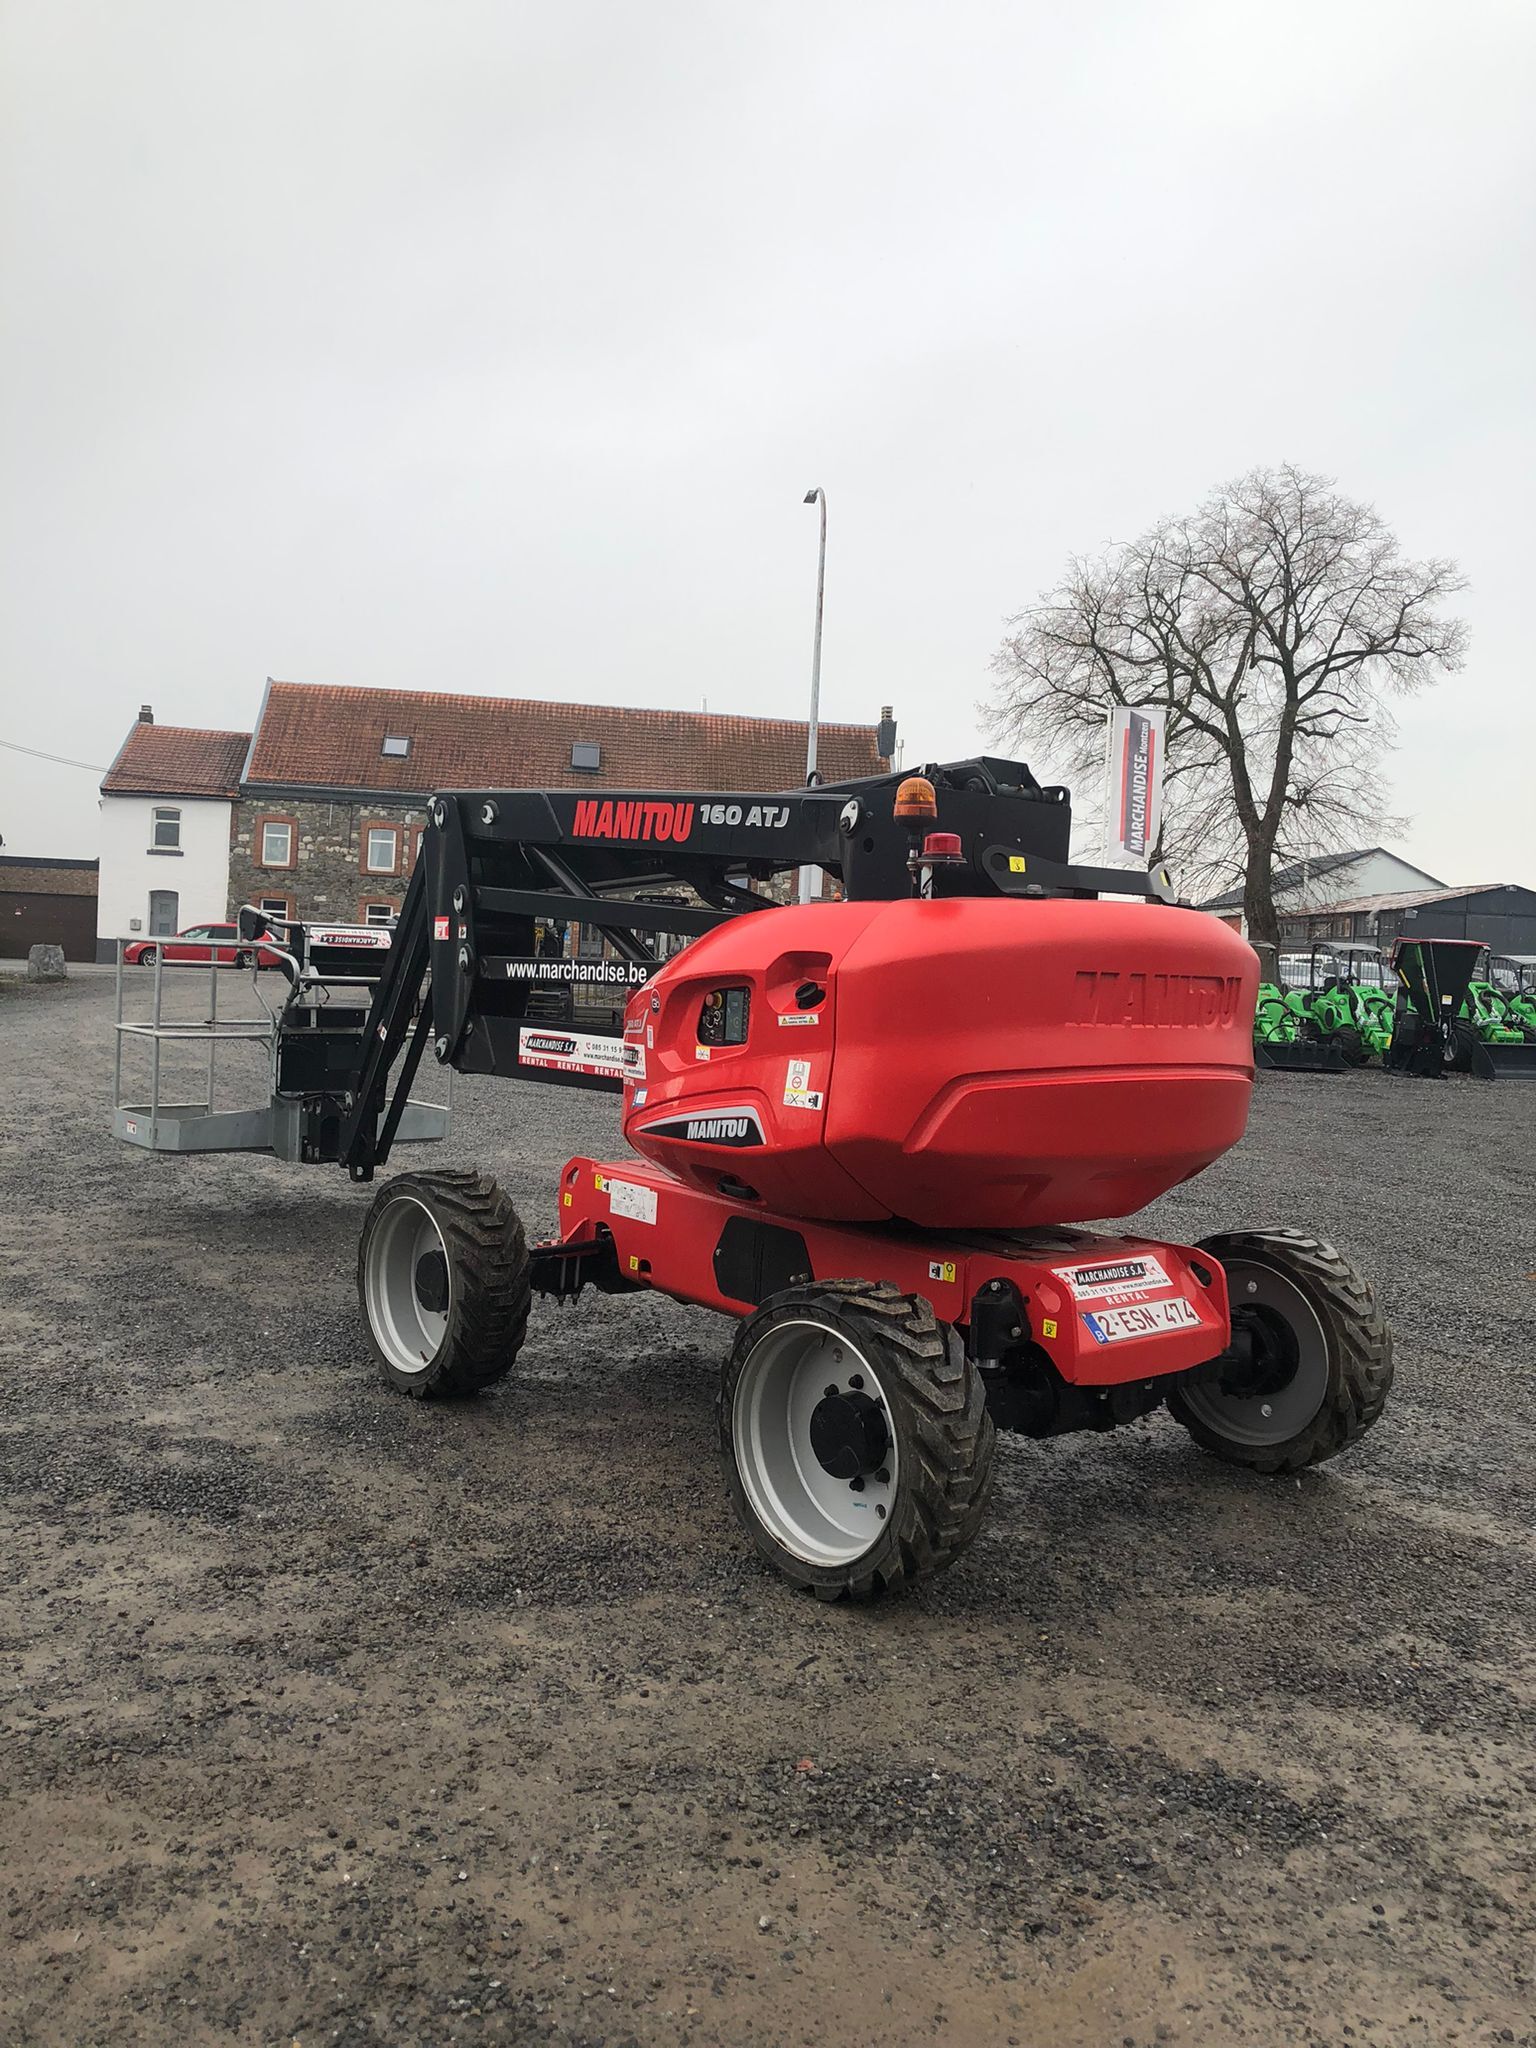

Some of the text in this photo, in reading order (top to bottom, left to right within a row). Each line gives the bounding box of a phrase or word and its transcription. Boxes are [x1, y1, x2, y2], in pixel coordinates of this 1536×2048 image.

[1130, 722, 1149, 852] Montzen MARCHANDISE
[572, 800, 790, 843] MANITOU 160 ATJ
[506, 960, 648, 984] www.marchandise.be
[527, 1037, 564, 1051] MARCHANDISE
[611, 1046, 617, 1054] 15
[583, 1052, 624, 1064] www.marchandise.b
[522, 1057, 548, 1067] RENTAL
[557, 1061, 585, 1073] RENTAL
[594, 1066, 624, 1078] RENTAL
[687, 1118, 748, 1140] MANITOU
[1077, 1266, 1130, 1283] MARCHANDISE
[1121, 1277, 1169, 1290] www.marchandise.be
[1105, 1291, 1150, 1305] RENTAL
[1095, 1330, 1105, 1341] B
